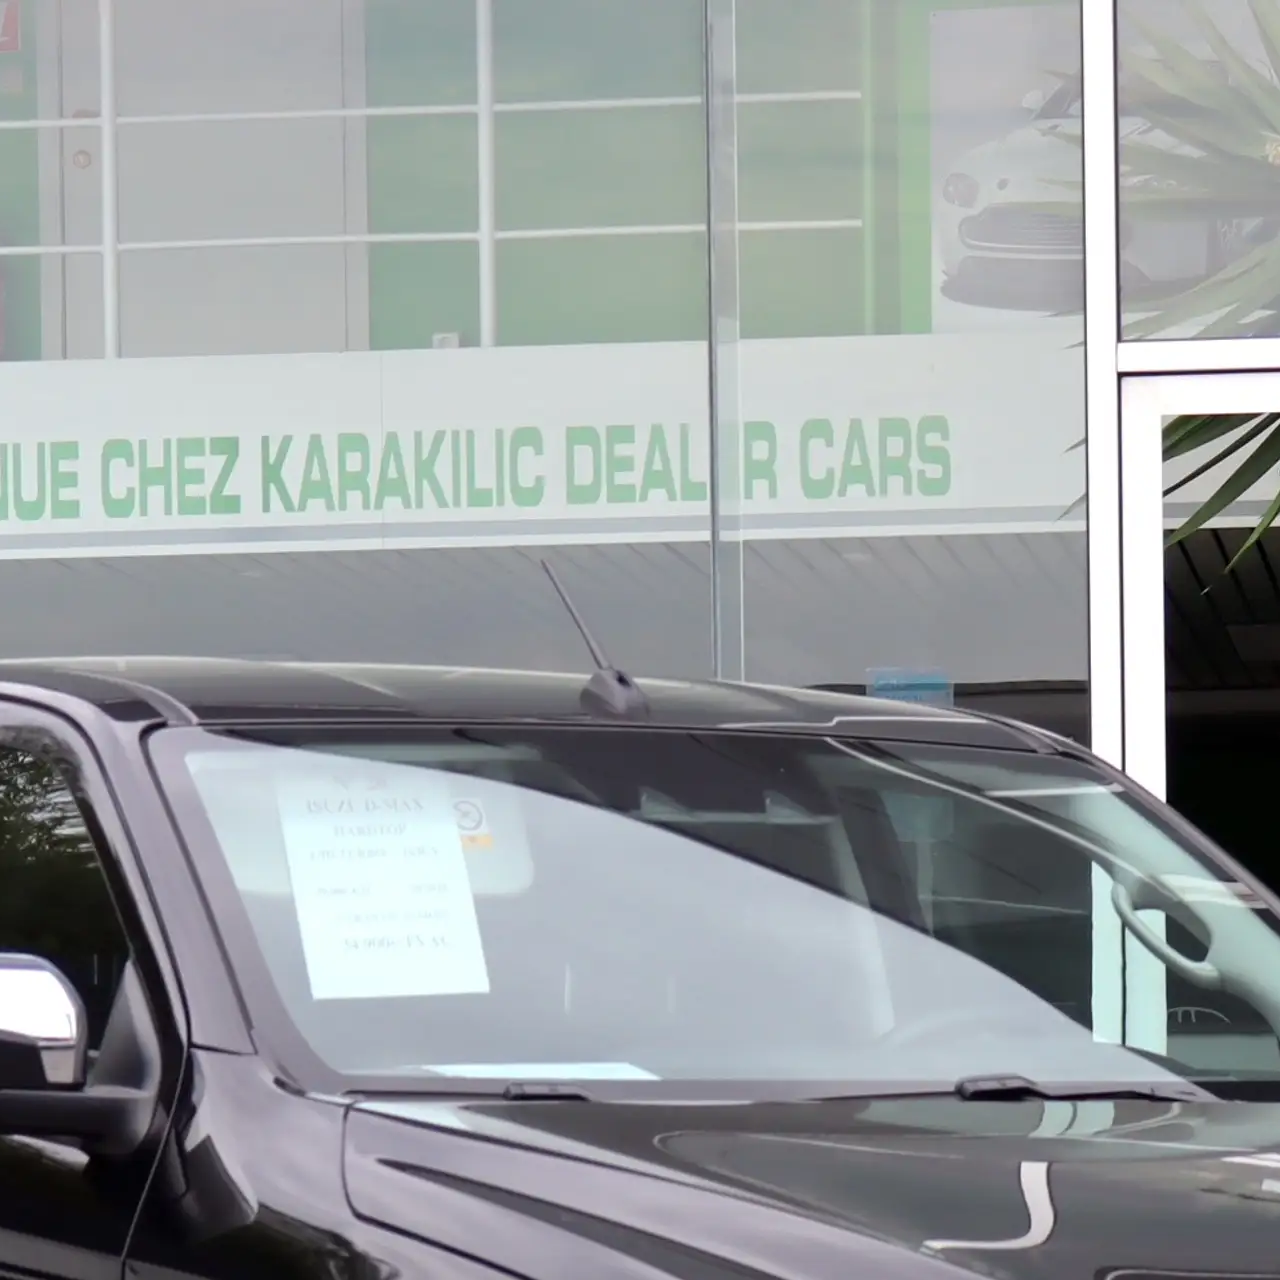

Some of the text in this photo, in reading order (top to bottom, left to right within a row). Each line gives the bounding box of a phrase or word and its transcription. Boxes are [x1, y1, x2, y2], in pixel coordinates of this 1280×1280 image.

[100, 436, 242, 518] CHEZ
[262, 426, 547, 514] KARAKILIC
[565, 420, 778, 505] DEALR
[799, 415, 952, 500] CARS
